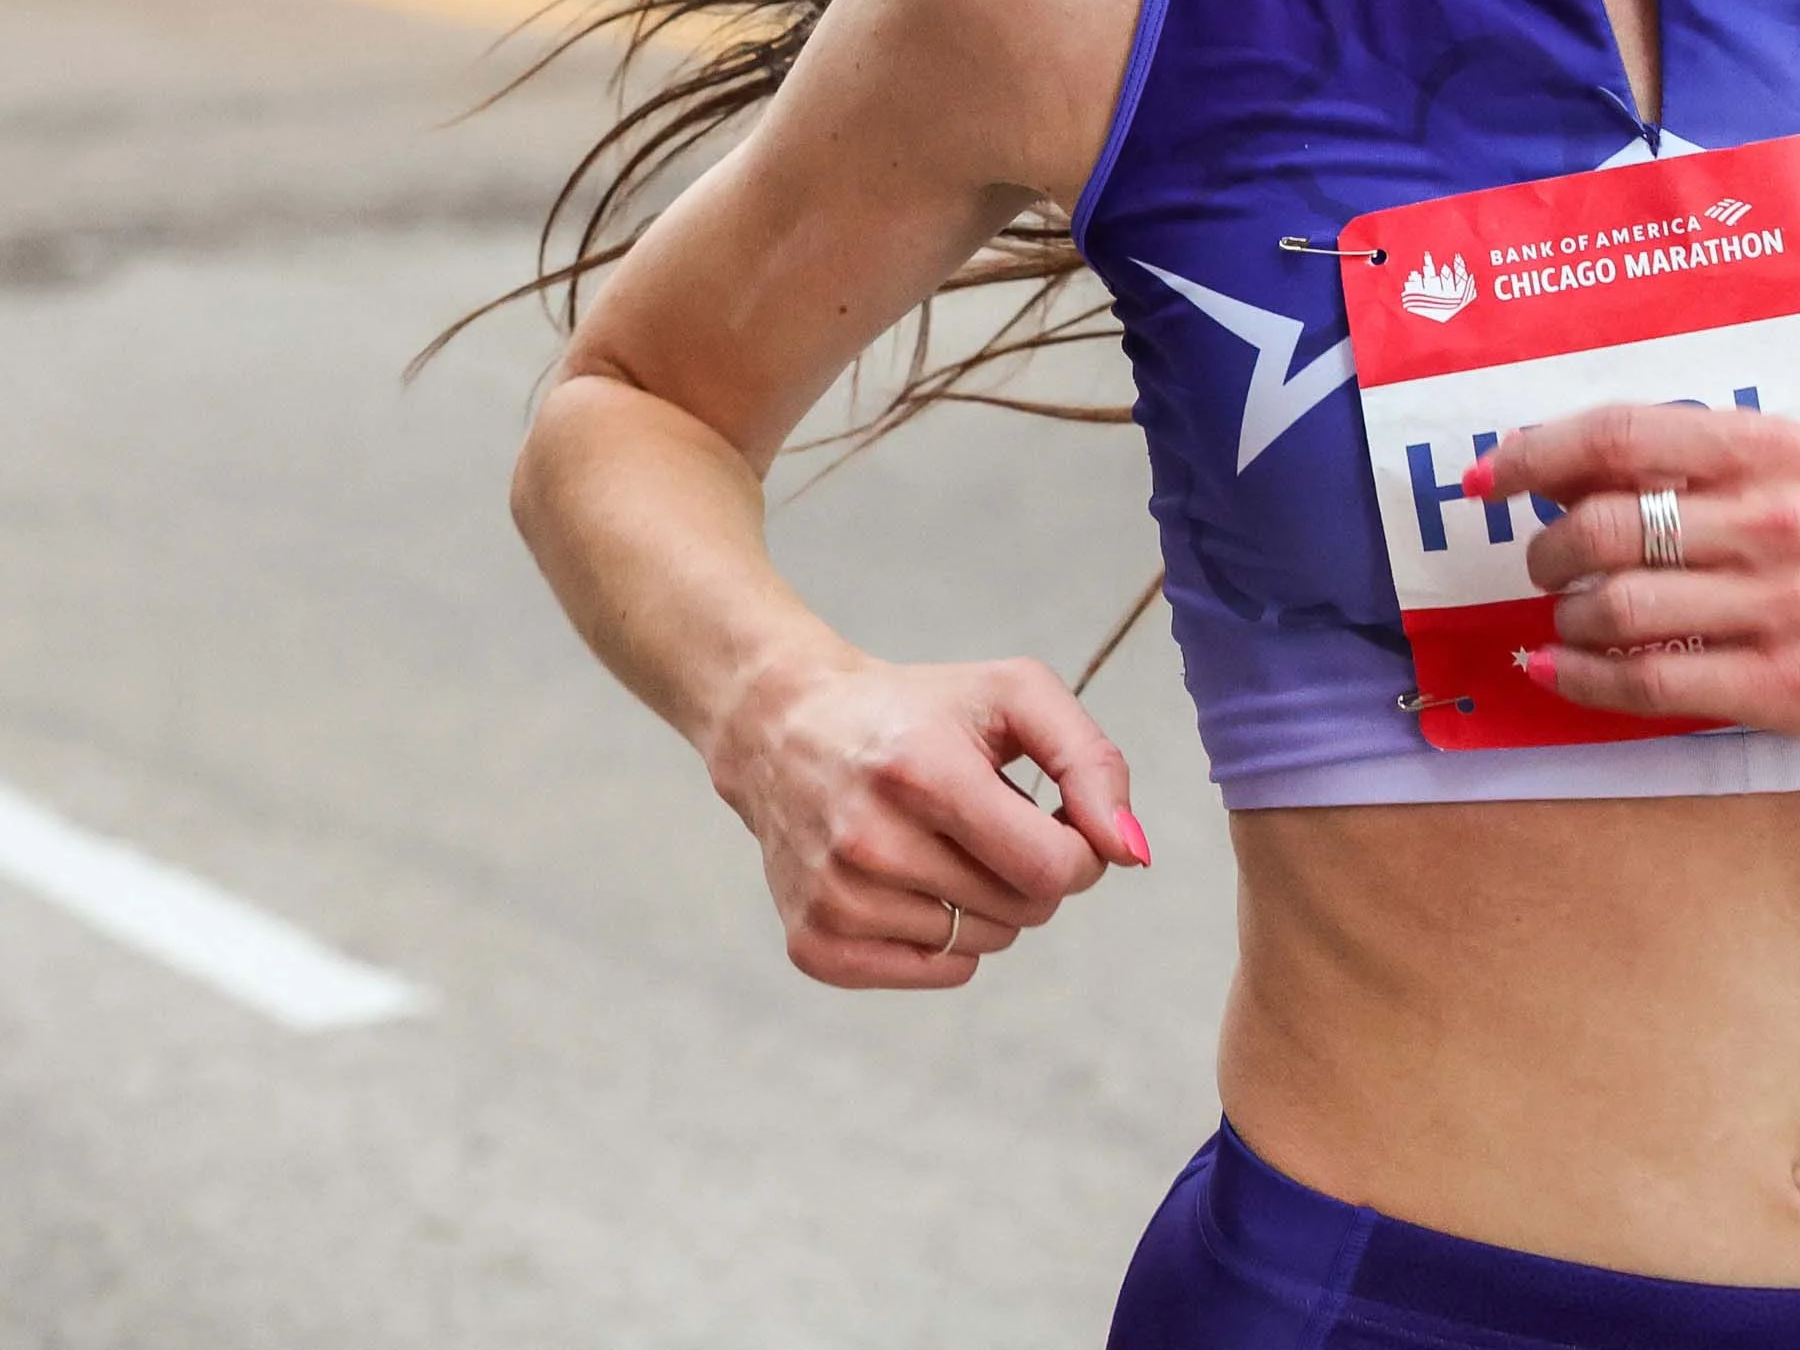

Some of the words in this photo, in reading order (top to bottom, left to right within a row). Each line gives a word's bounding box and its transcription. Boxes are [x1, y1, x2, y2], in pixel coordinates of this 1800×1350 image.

[1490, 240, 1554, 267] BANK
[1560, 233, 1590, 255] OF
[1596, 215, 1702, 248] AMERICA
[1493, 256, 1616, 302] CHICAGO
[1626, 228, 1785, 279] MARATHON
